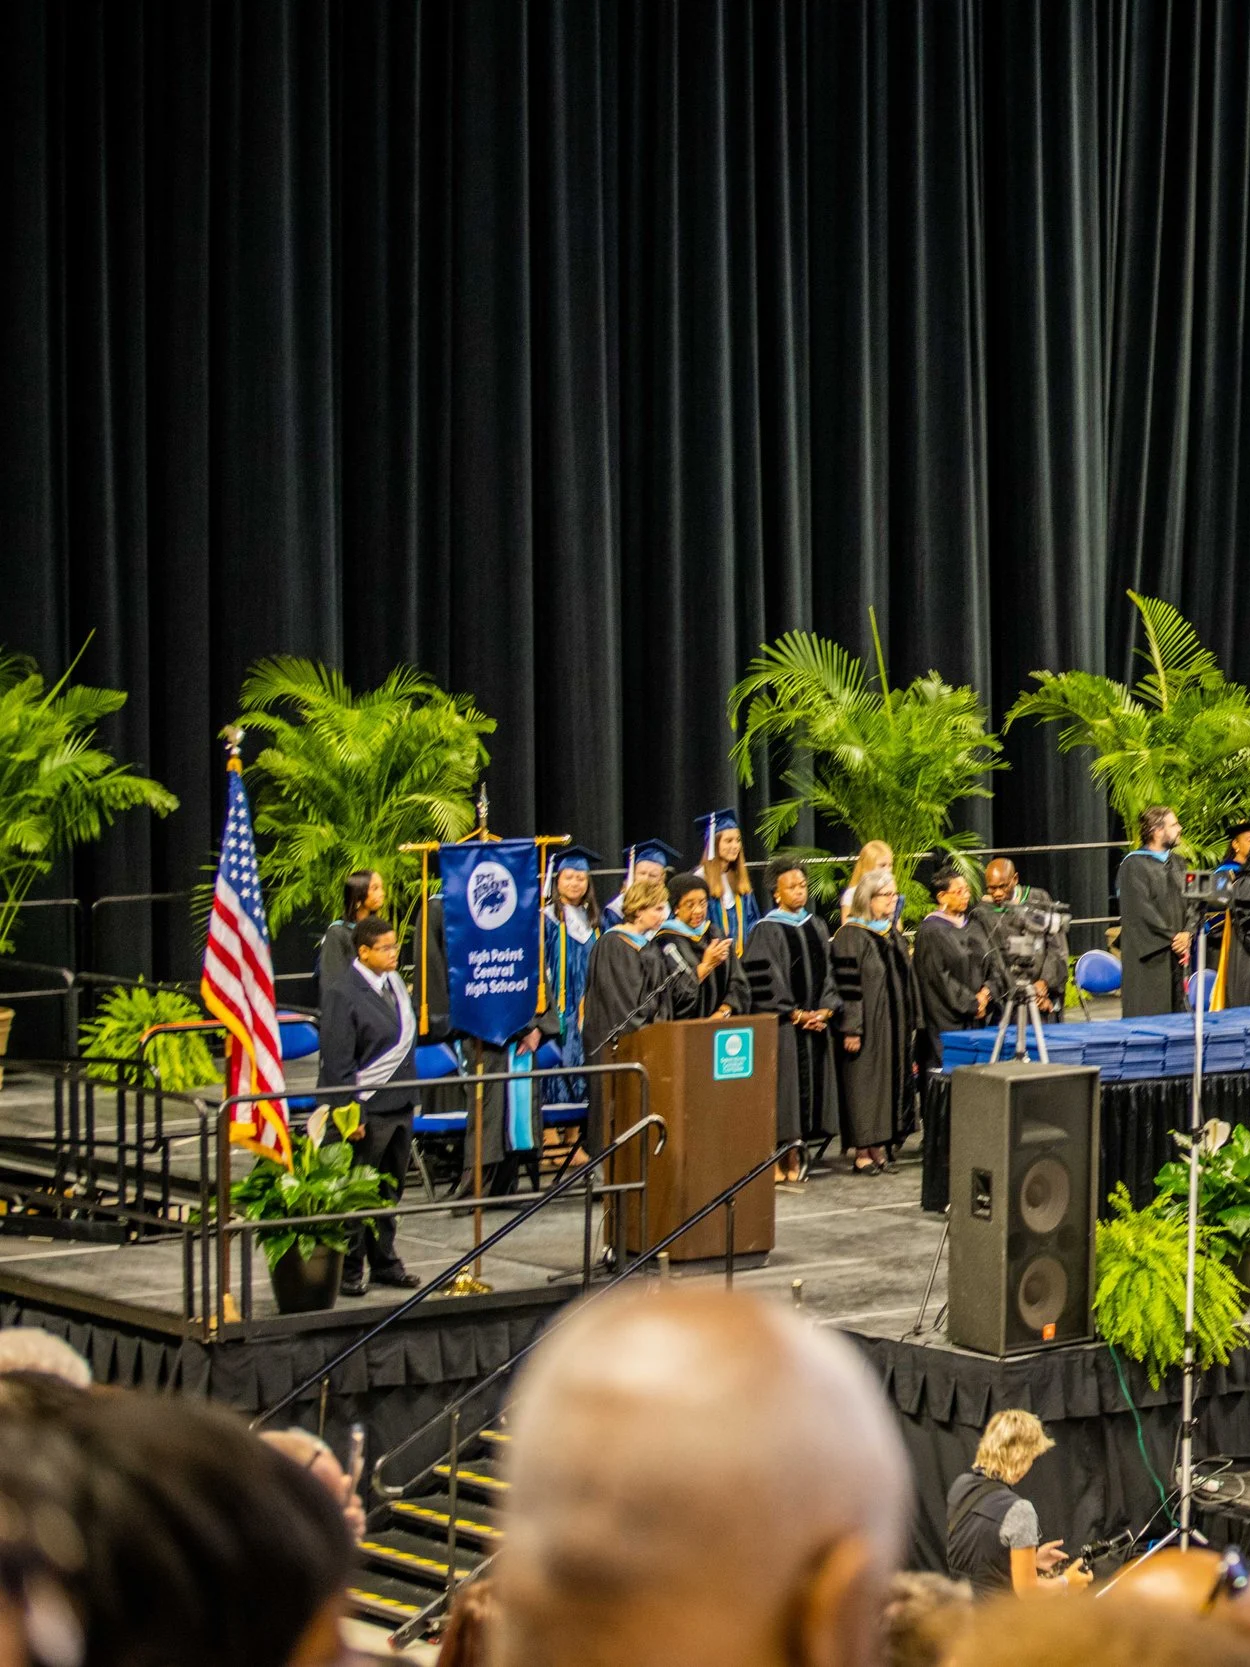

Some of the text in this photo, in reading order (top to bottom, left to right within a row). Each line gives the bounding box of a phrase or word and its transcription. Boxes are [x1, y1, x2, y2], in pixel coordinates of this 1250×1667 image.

[468, 947, 524, 967] High Point
[473, 962, 515, 980] Central
[465, 976, 529, 998] High School
